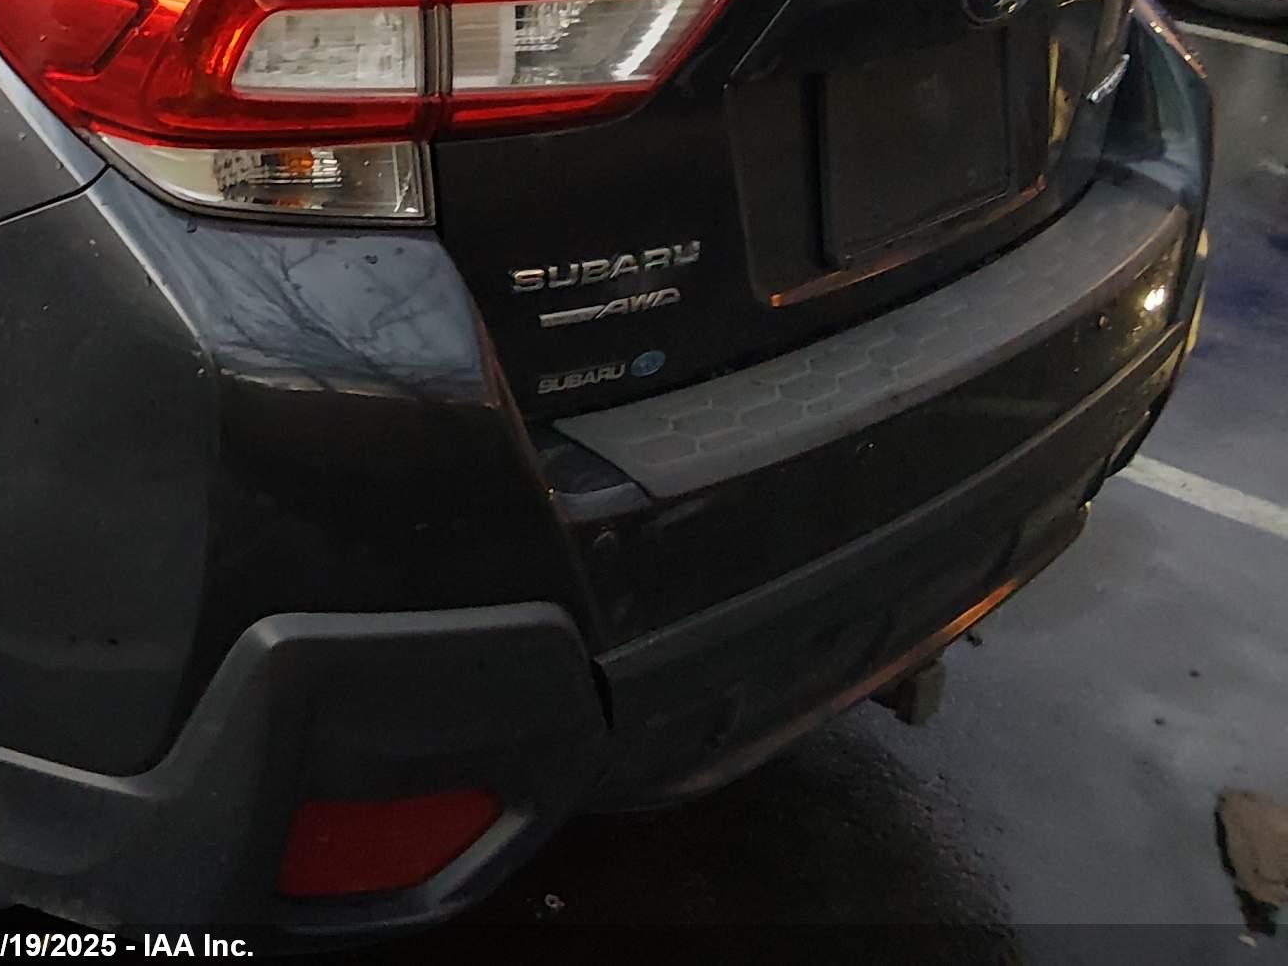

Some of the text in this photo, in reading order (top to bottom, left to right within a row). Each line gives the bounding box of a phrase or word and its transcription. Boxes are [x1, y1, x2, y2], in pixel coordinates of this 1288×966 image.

[511, 240, 701, 291] SUBARU
[595, 287, 681, 320] AWD
[537, 363, 626, 394] SUBARU
